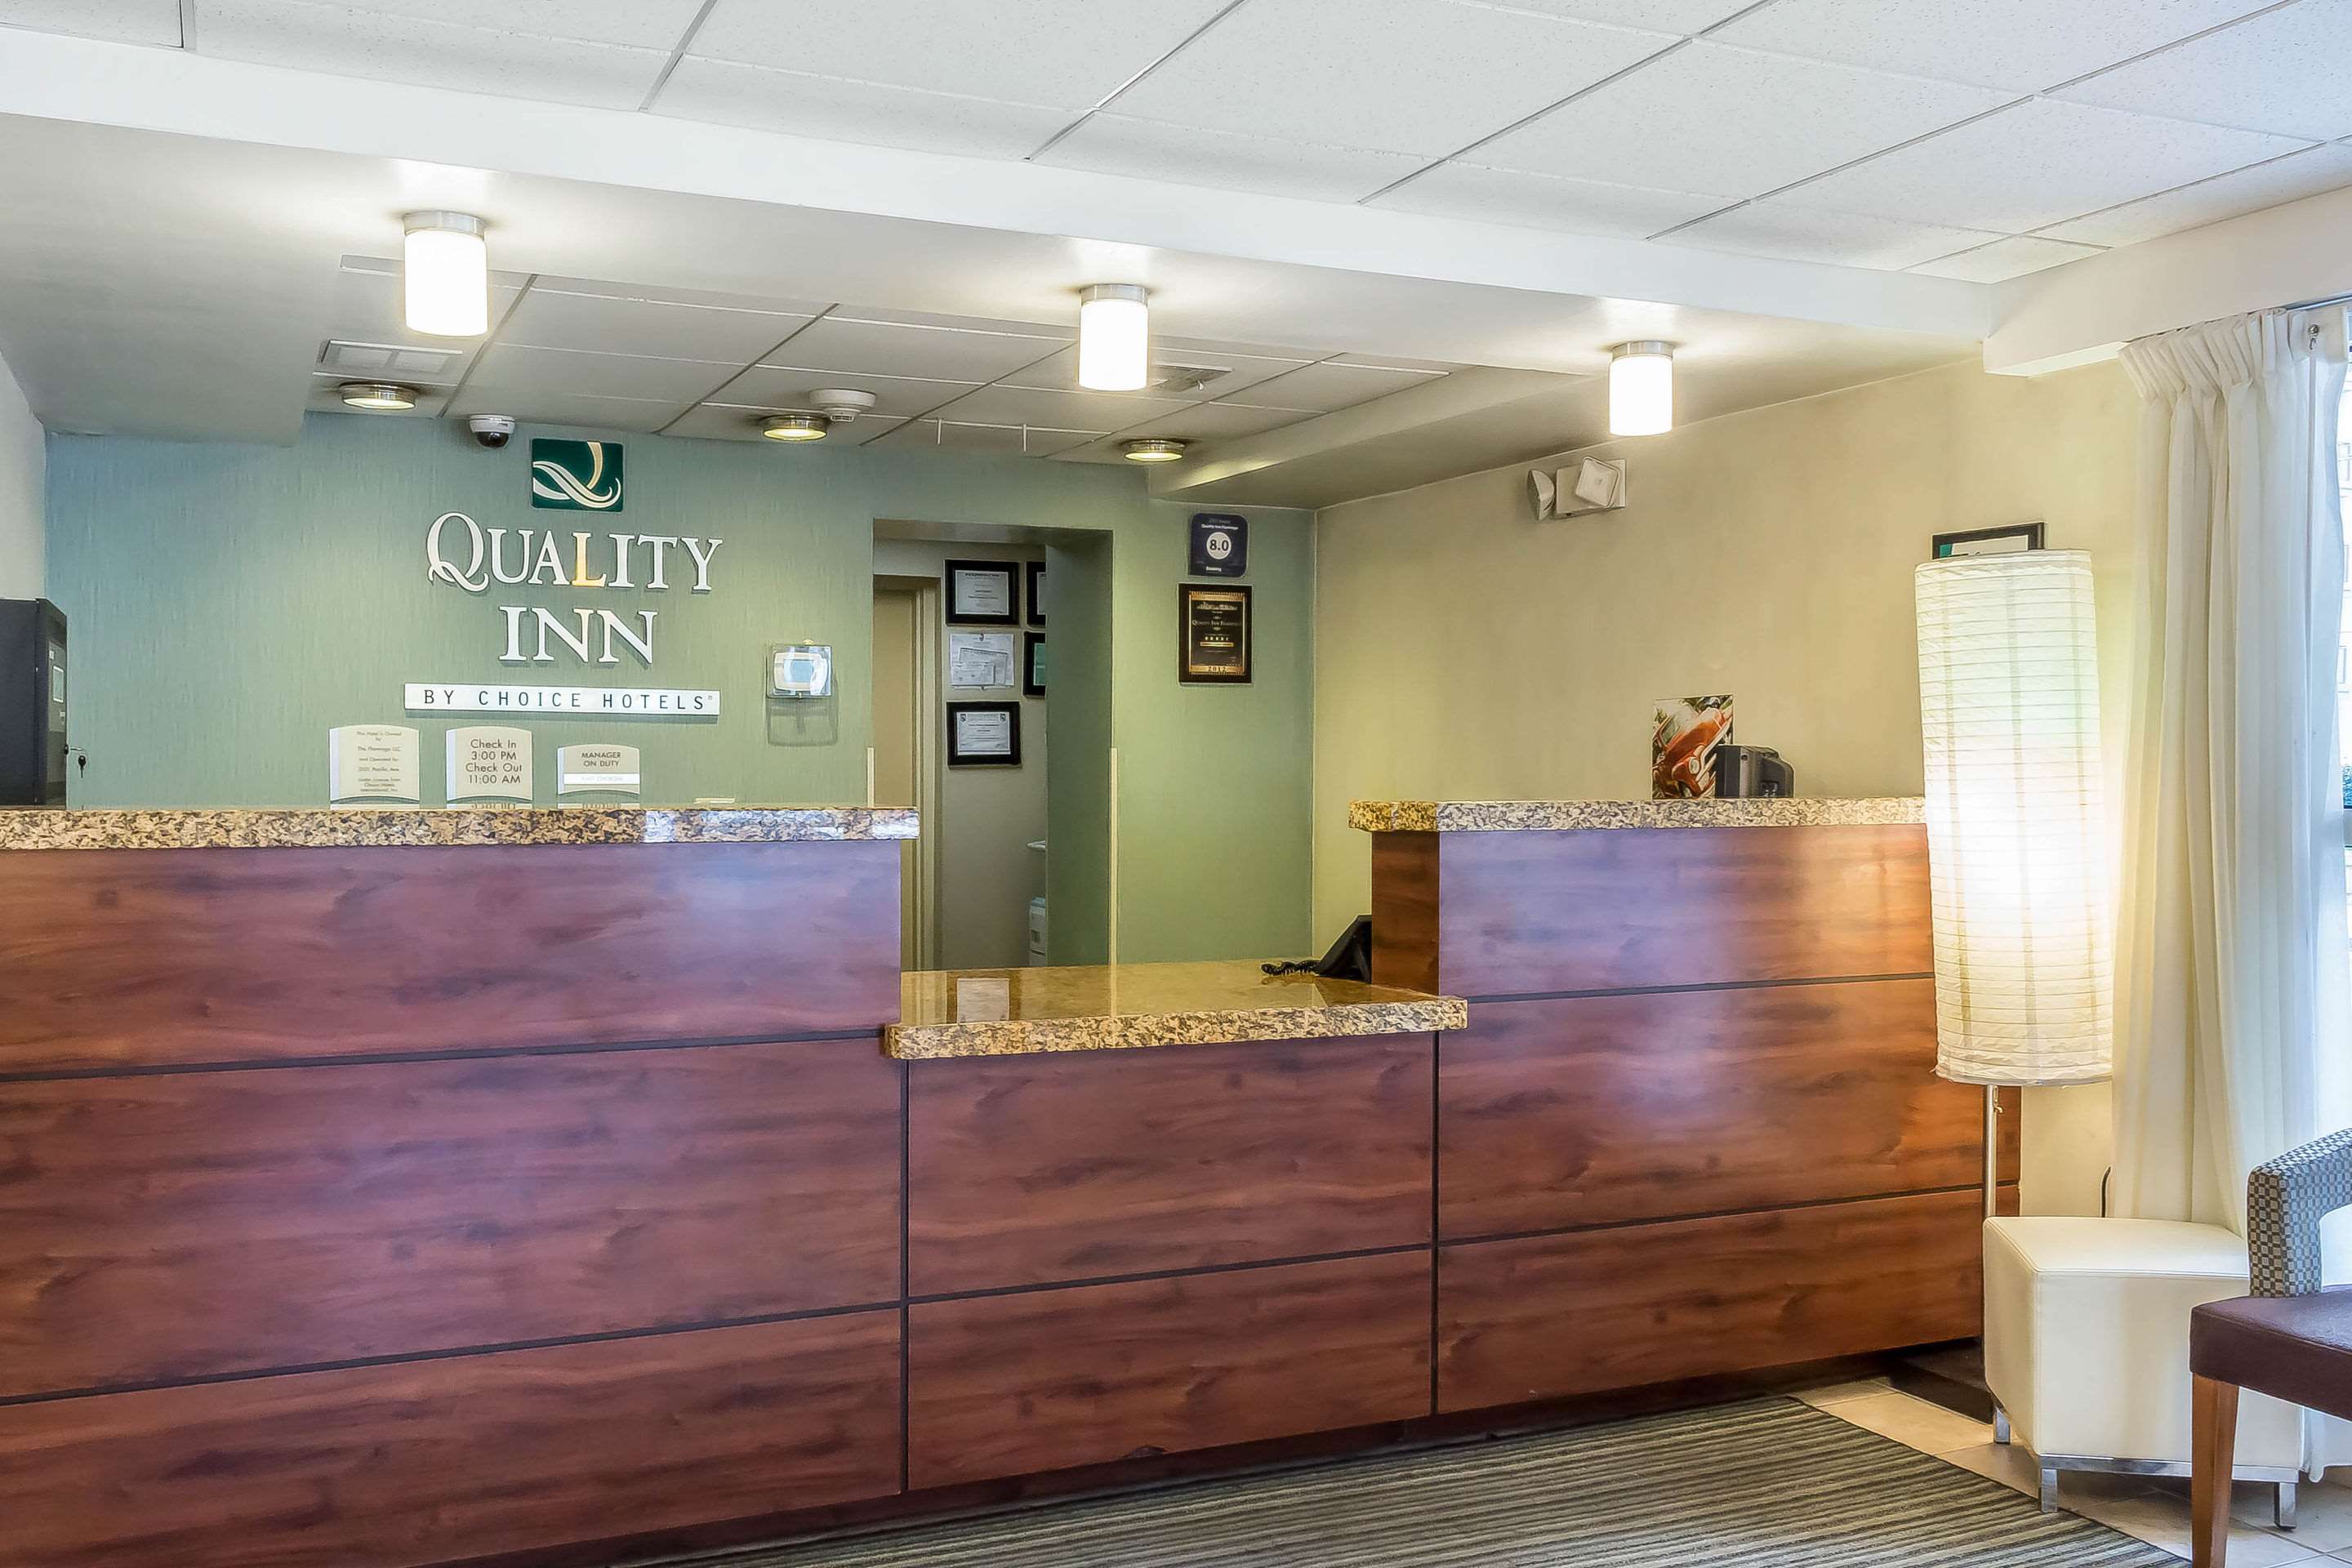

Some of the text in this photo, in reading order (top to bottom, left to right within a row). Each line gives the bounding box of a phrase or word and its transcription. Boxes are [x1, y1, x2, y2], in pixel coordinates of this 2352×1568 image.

[1209, 539, 1229, 551] 8.0
[426, 511, 723, 591] QUALITY
[499, 606, 658, 664] INN
[424, 689, 454, 704] BY
[478, 691, 581, 707] CHOICE
[470, 738, 517, 749] Check In
[471, 751, 517, 760] 3:00 PM
[466, 762, 522, 773] Check Out
[469, 774, 520, 784] 11:00 AM
